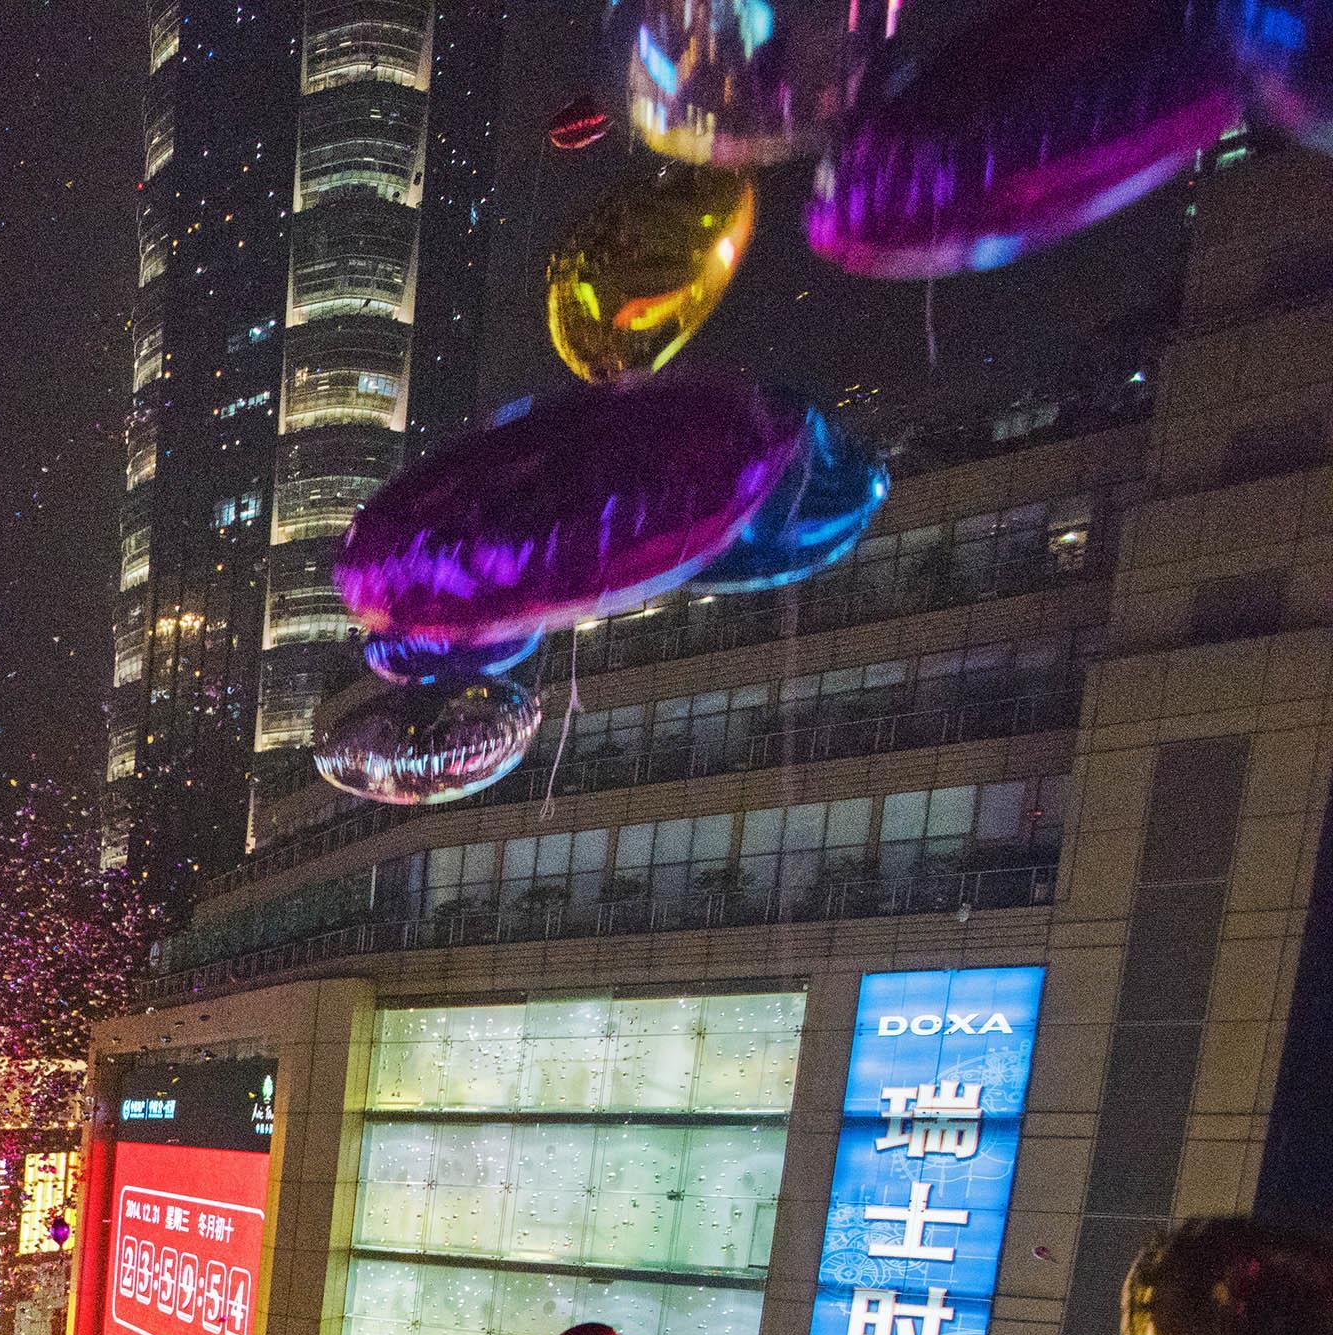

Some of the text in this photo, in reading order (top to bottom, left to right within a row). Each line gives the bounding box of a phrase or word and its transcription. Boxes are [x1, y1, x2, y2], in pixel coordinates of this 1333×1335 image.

[878, 1013, 1013, 1037] DOXA
[125, 1200, 234, 1243] 2014.12.31 星期三 冬月初十
